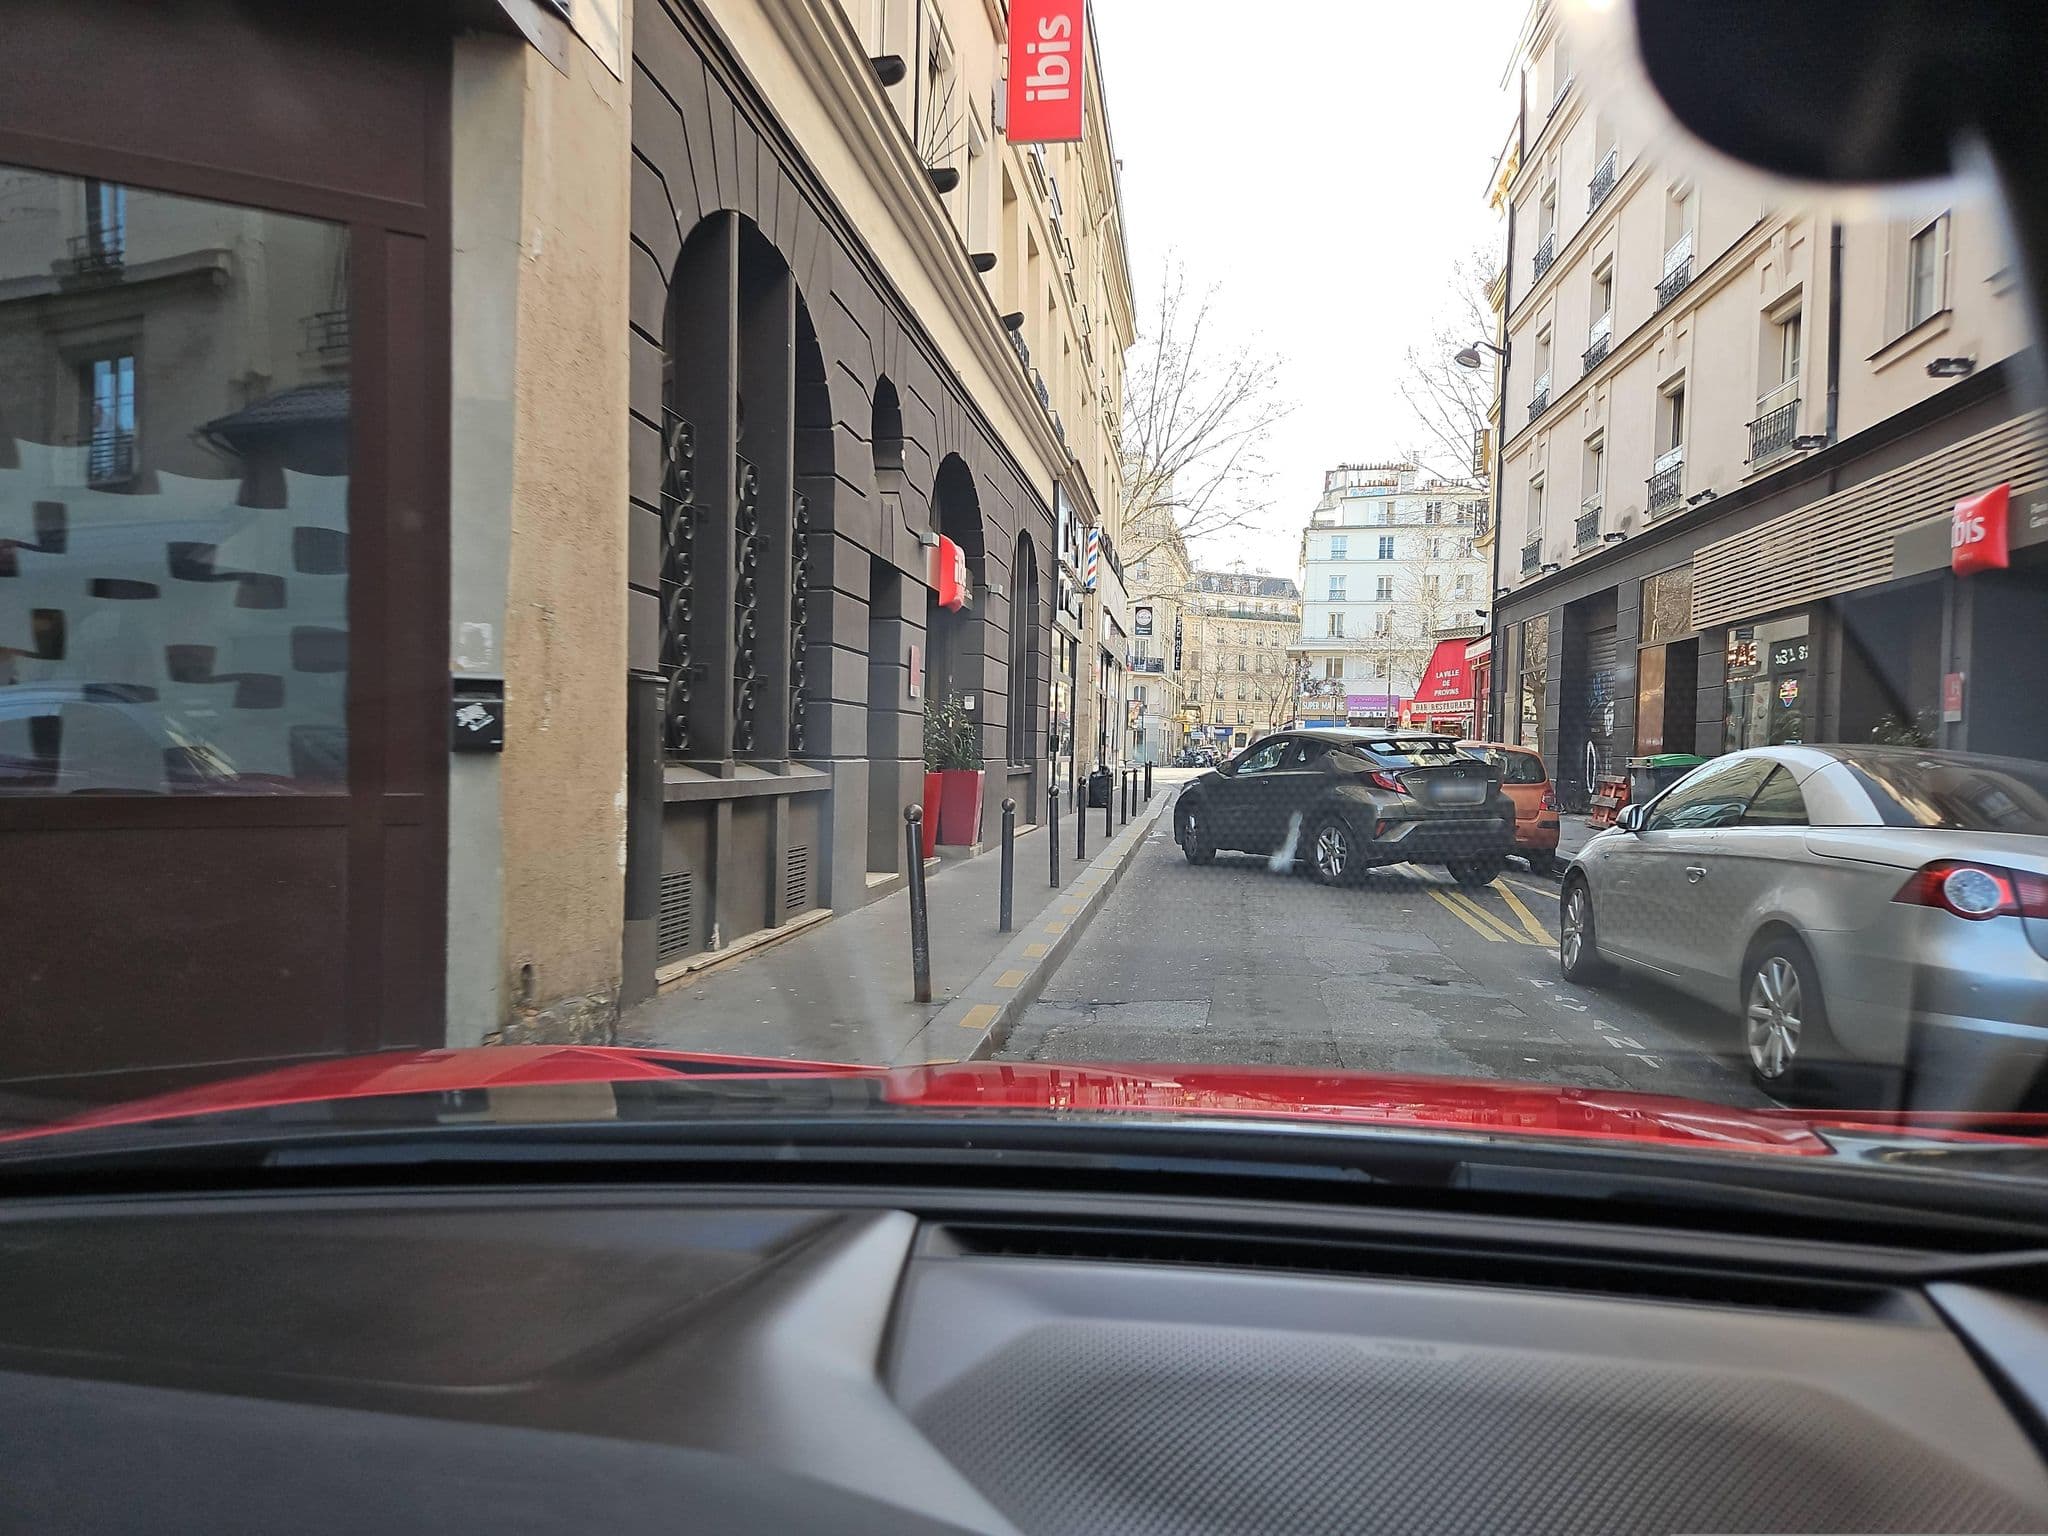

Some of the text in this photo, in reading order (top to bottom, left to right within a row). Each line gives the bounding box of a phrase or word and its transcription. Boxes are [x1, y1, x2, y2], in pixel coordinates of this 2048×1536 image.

[1025, 14, 1072, 102] ibis
[1442, 669, 1460, 678] VILLE
[1434, 687, 1459, 697] PROVINS
[1302, 701, 1320, 710] SUPER
[1415, 700, 1472, 711] BAR RESTAURANT
